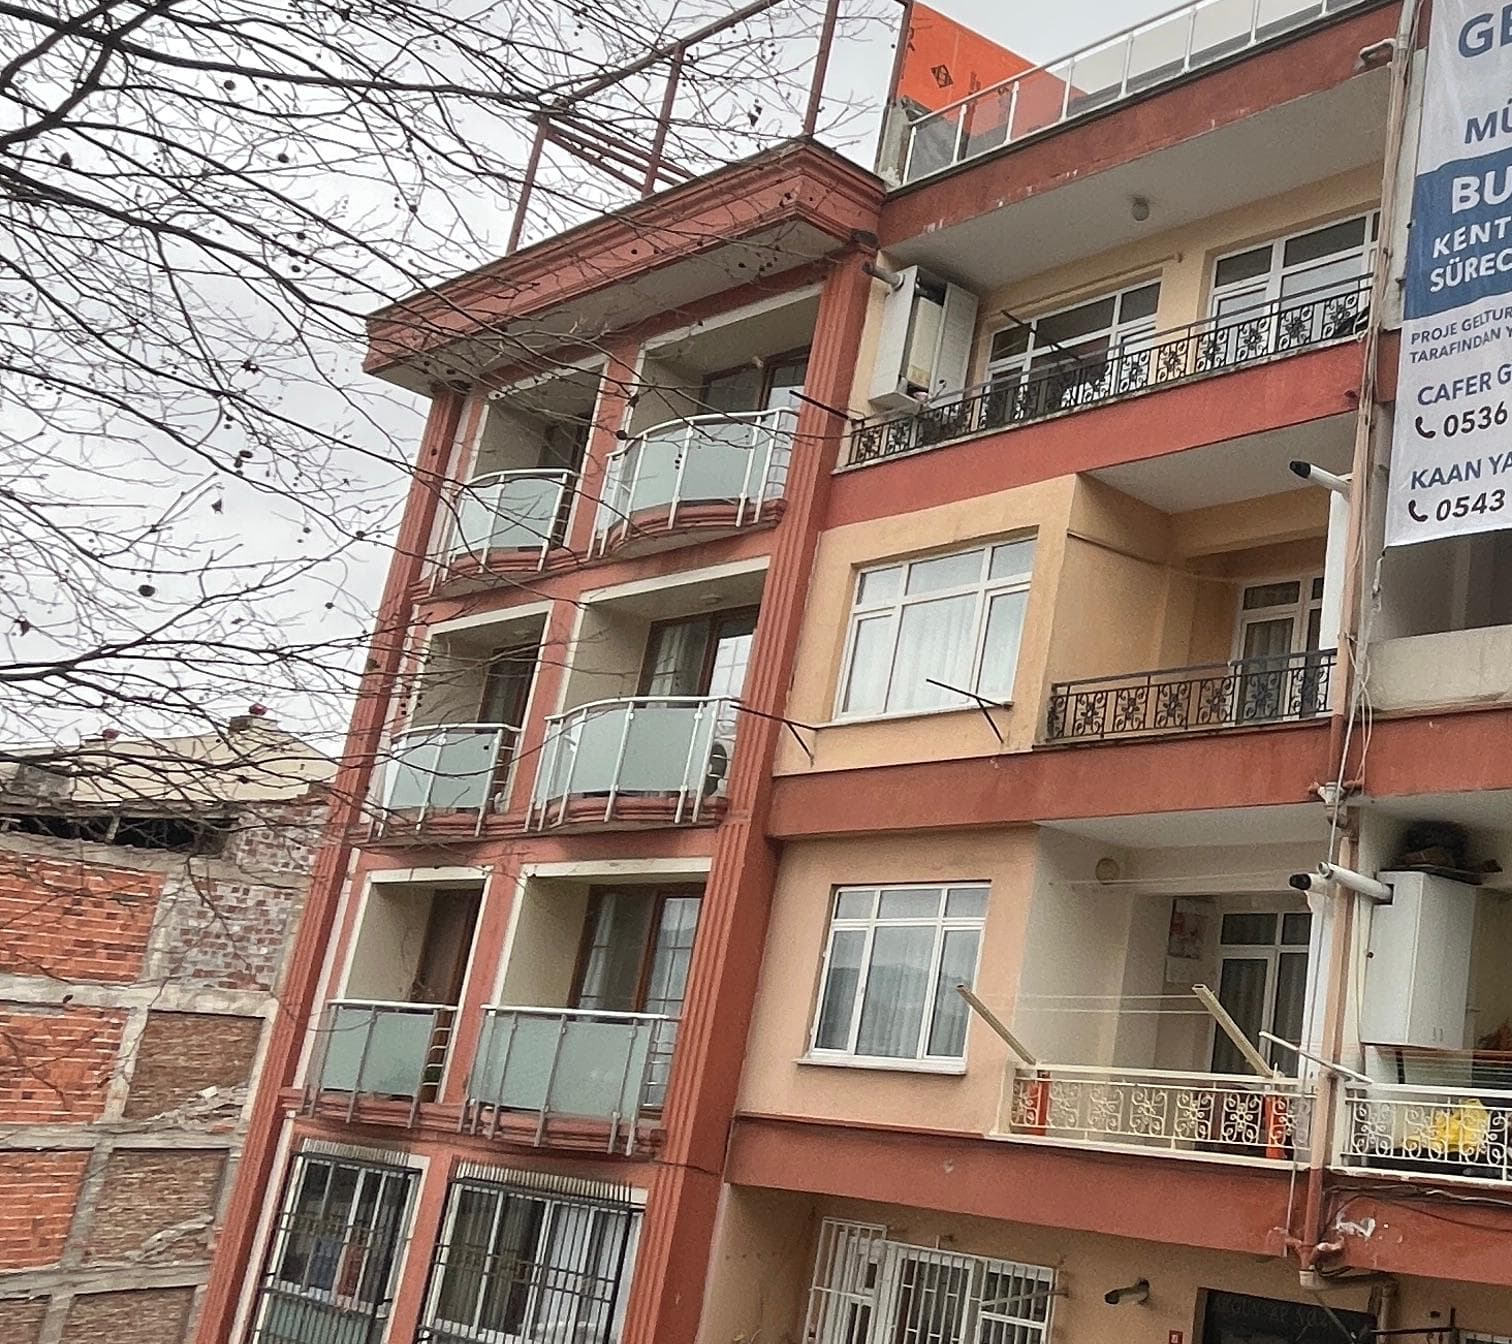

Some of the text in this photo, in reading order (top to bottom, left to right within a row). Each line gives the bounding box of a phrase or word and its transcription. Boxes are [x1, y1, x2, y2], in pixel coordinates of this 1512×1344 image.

[1409, 328, 1501, 364] TARAFINDAN
[1411, 322, 1457, 345] PROJE
[1417, 372, 1491, 405] CAFER
[1443, 402, 1508, 437] 0536
[1411, 459, 1481, 490] KAAN
[1436, 489, 1505, 522] 0543
